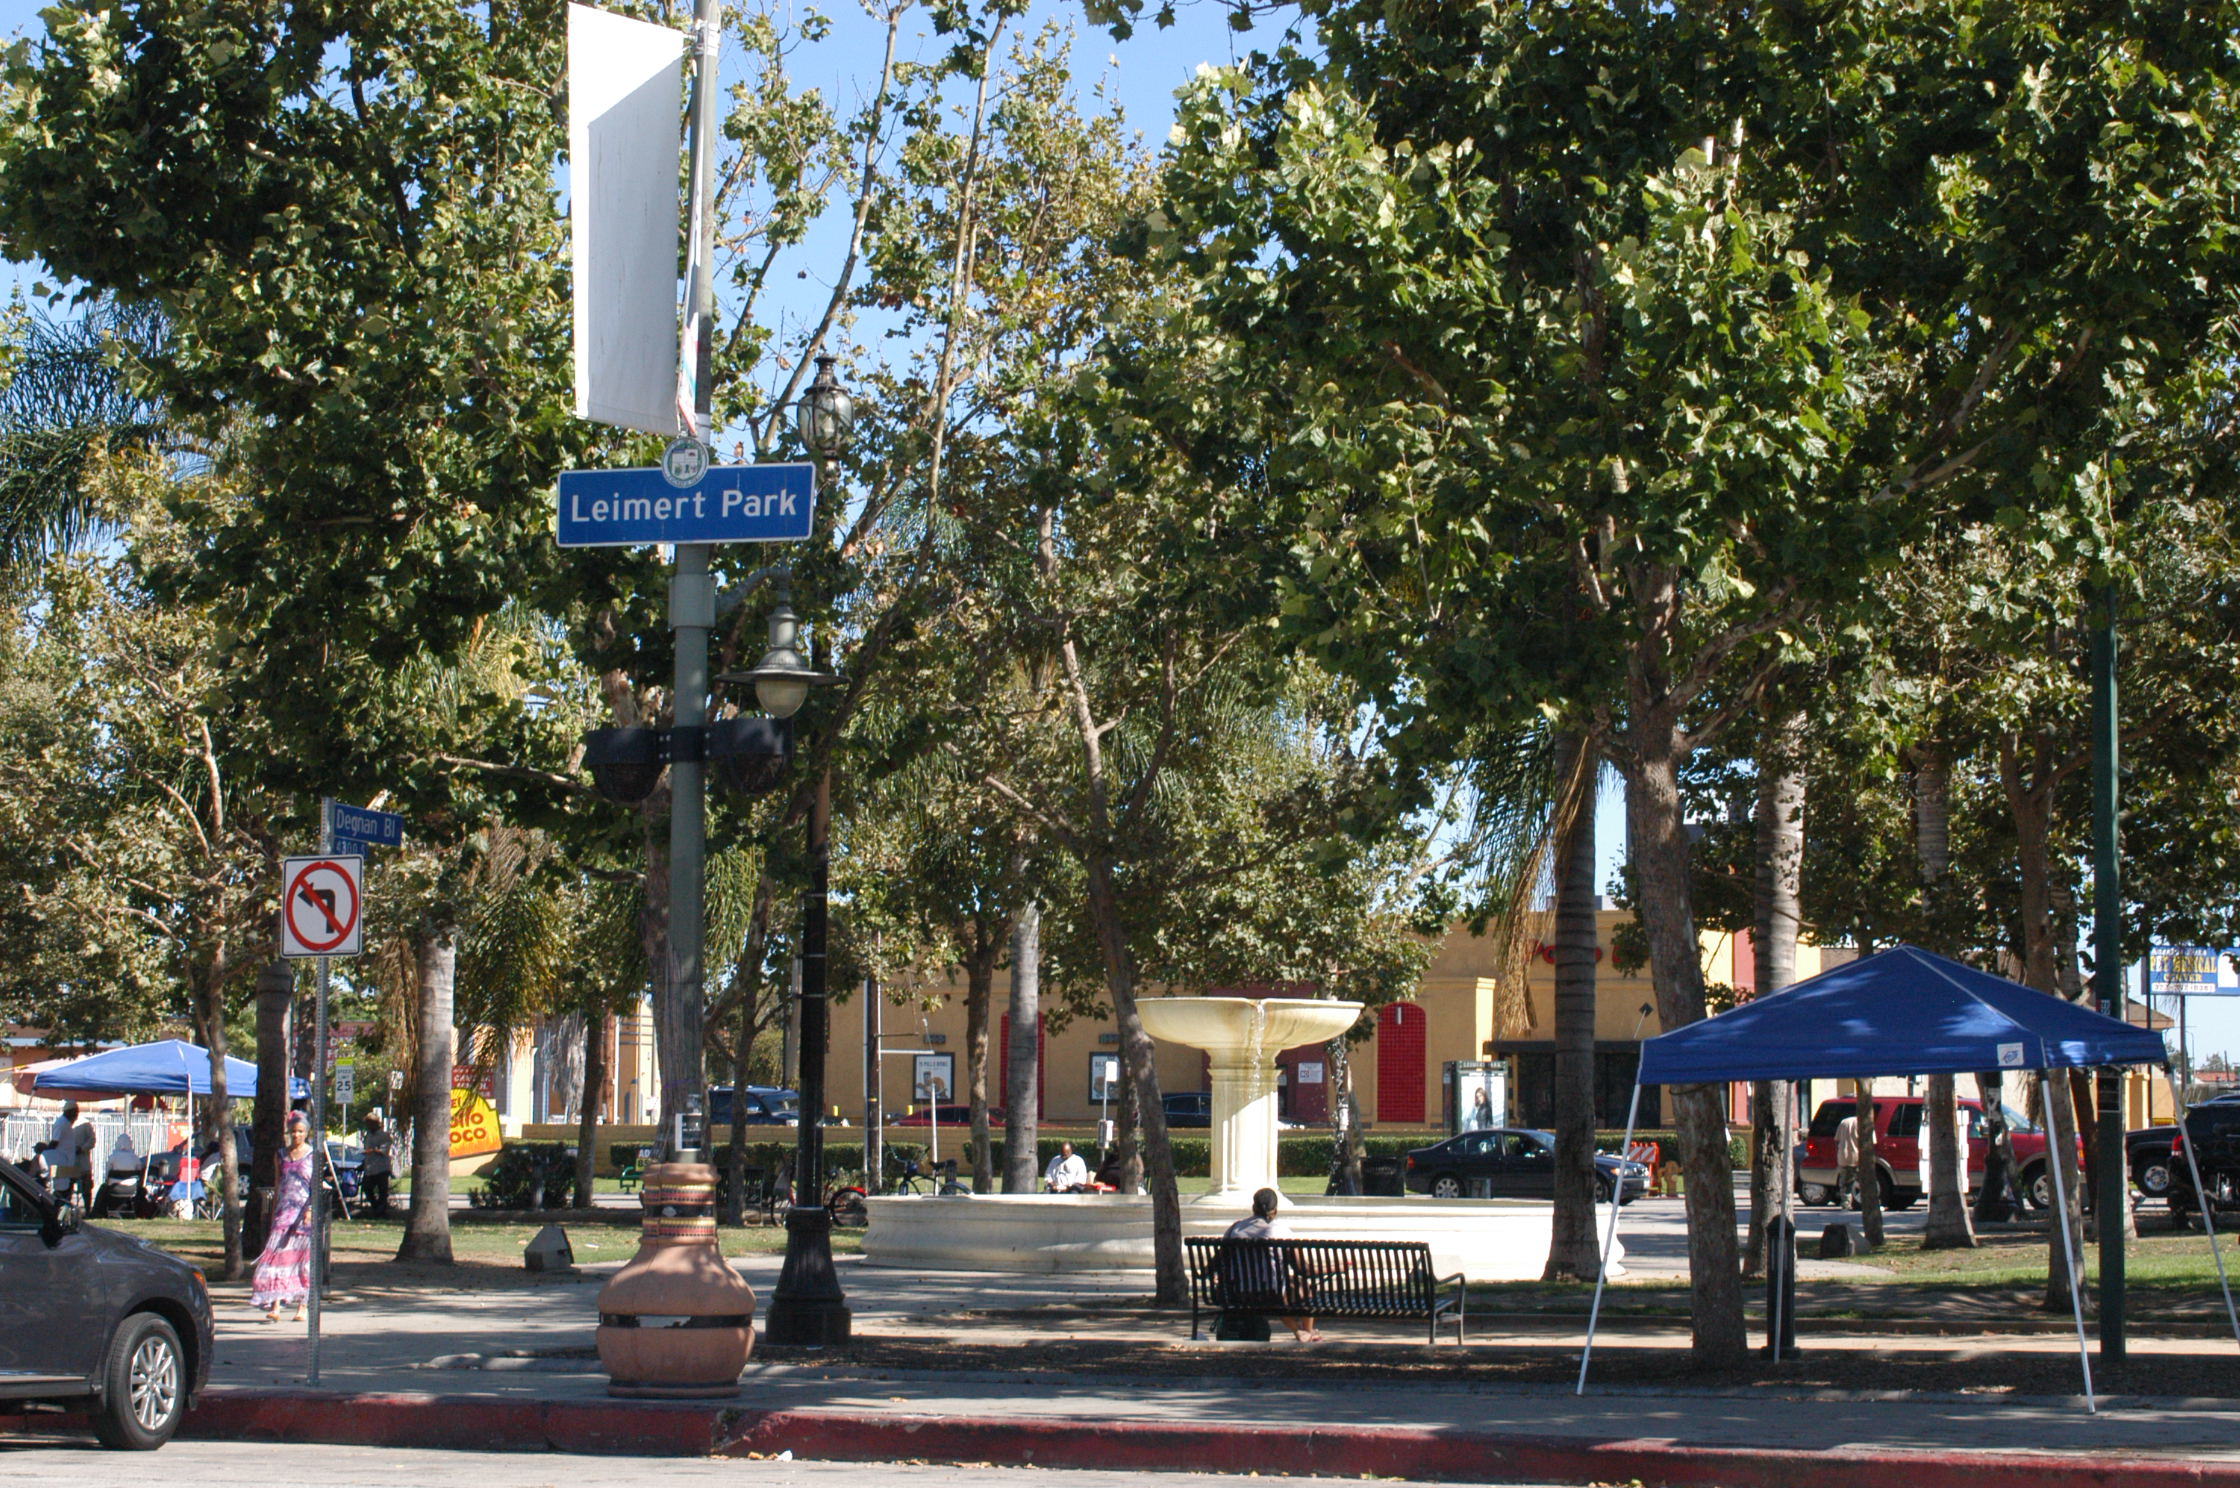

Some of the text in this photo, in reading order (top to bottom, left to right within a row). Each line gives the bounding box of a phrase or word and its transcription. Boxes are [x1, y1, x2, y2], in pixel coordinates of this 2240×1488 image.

[571, 489, 798, 522] Leimert Park
[336, 809, 396, 838] Degnan Bl
[337, 1081, 351, 1092] 25
[449, 1127, 487, 1143] oco
